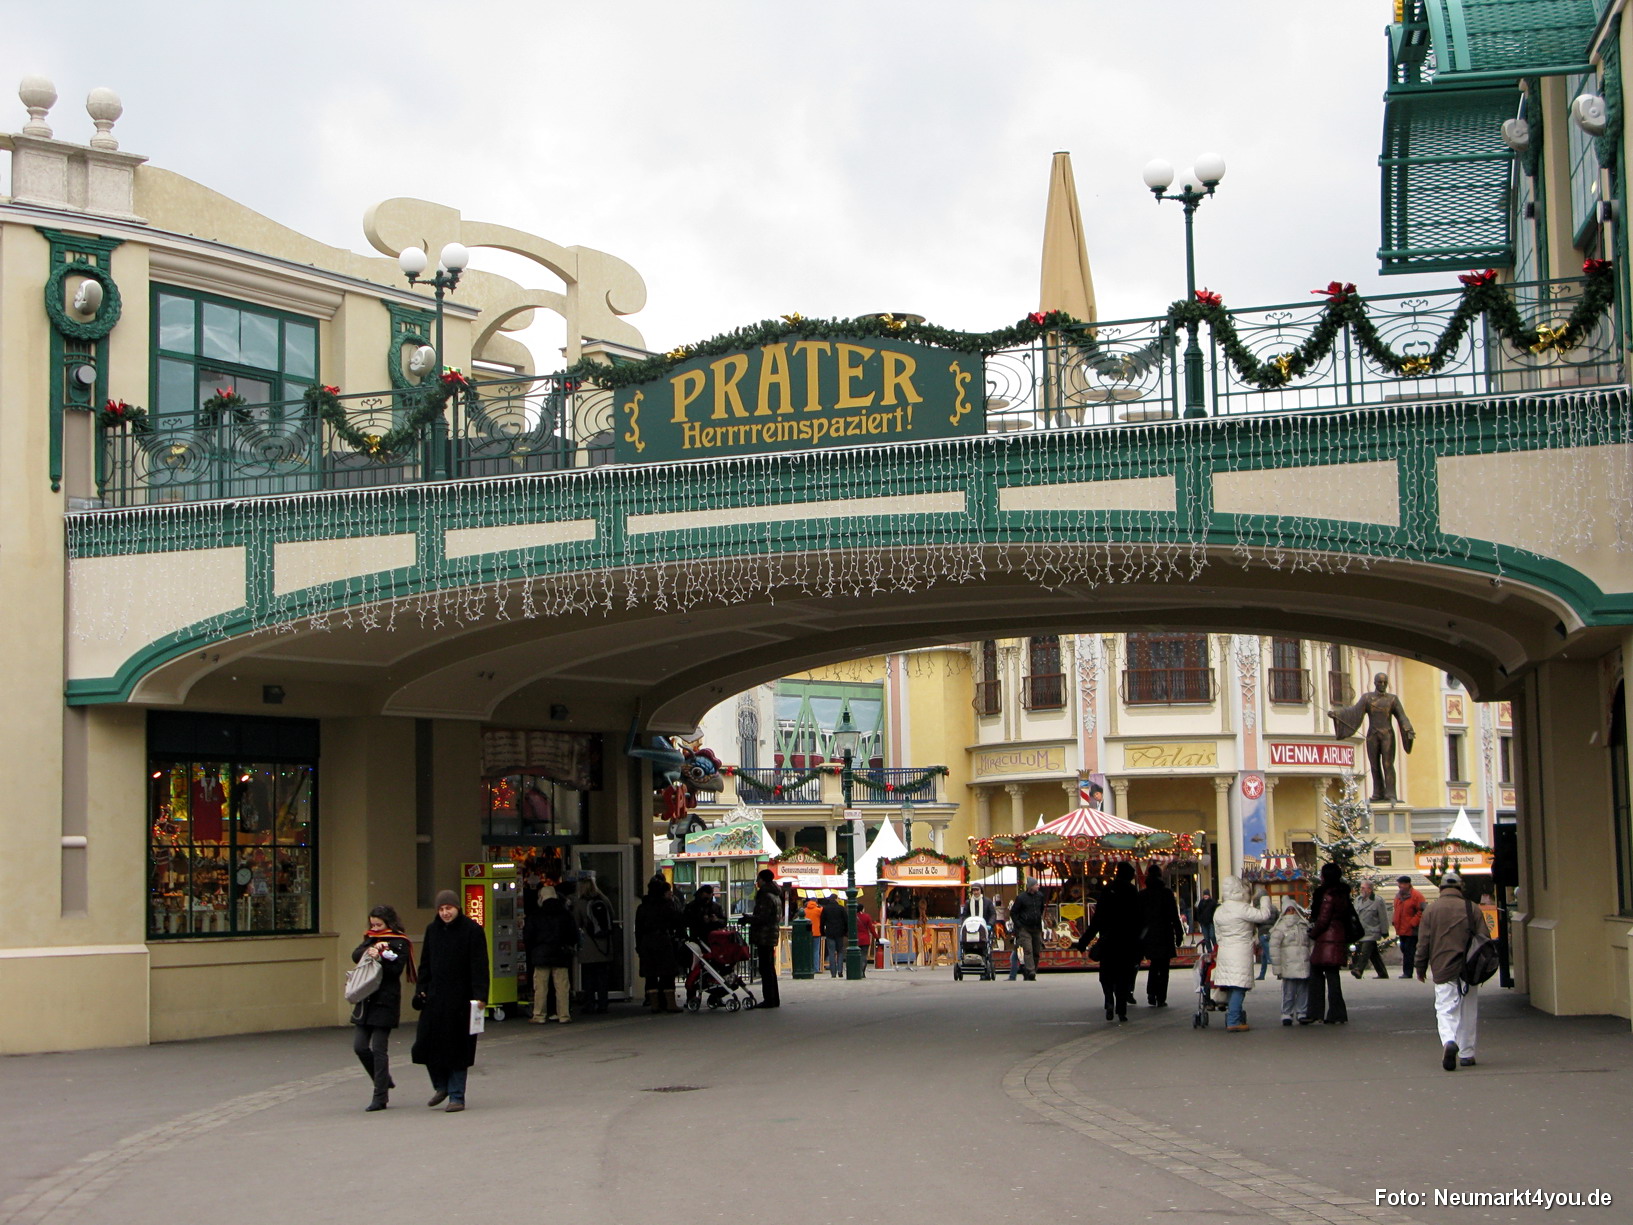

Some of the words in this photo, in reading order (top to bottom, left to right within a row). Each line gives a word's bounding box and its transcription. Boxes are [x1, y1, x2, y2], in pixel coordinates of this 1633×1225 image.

[670, 340, 923, 424] PRATER
[682, 405, 913, 449] Herrrreinspaziert!
[977, 750, 1060, 775] MIRACULUM
[1125, 745, 1216, 768] Palais
[1271, 745, 1320, 763] VIENNA
[908, 866, 923, 875] Kunst
[925, 866, 930, 875] &
